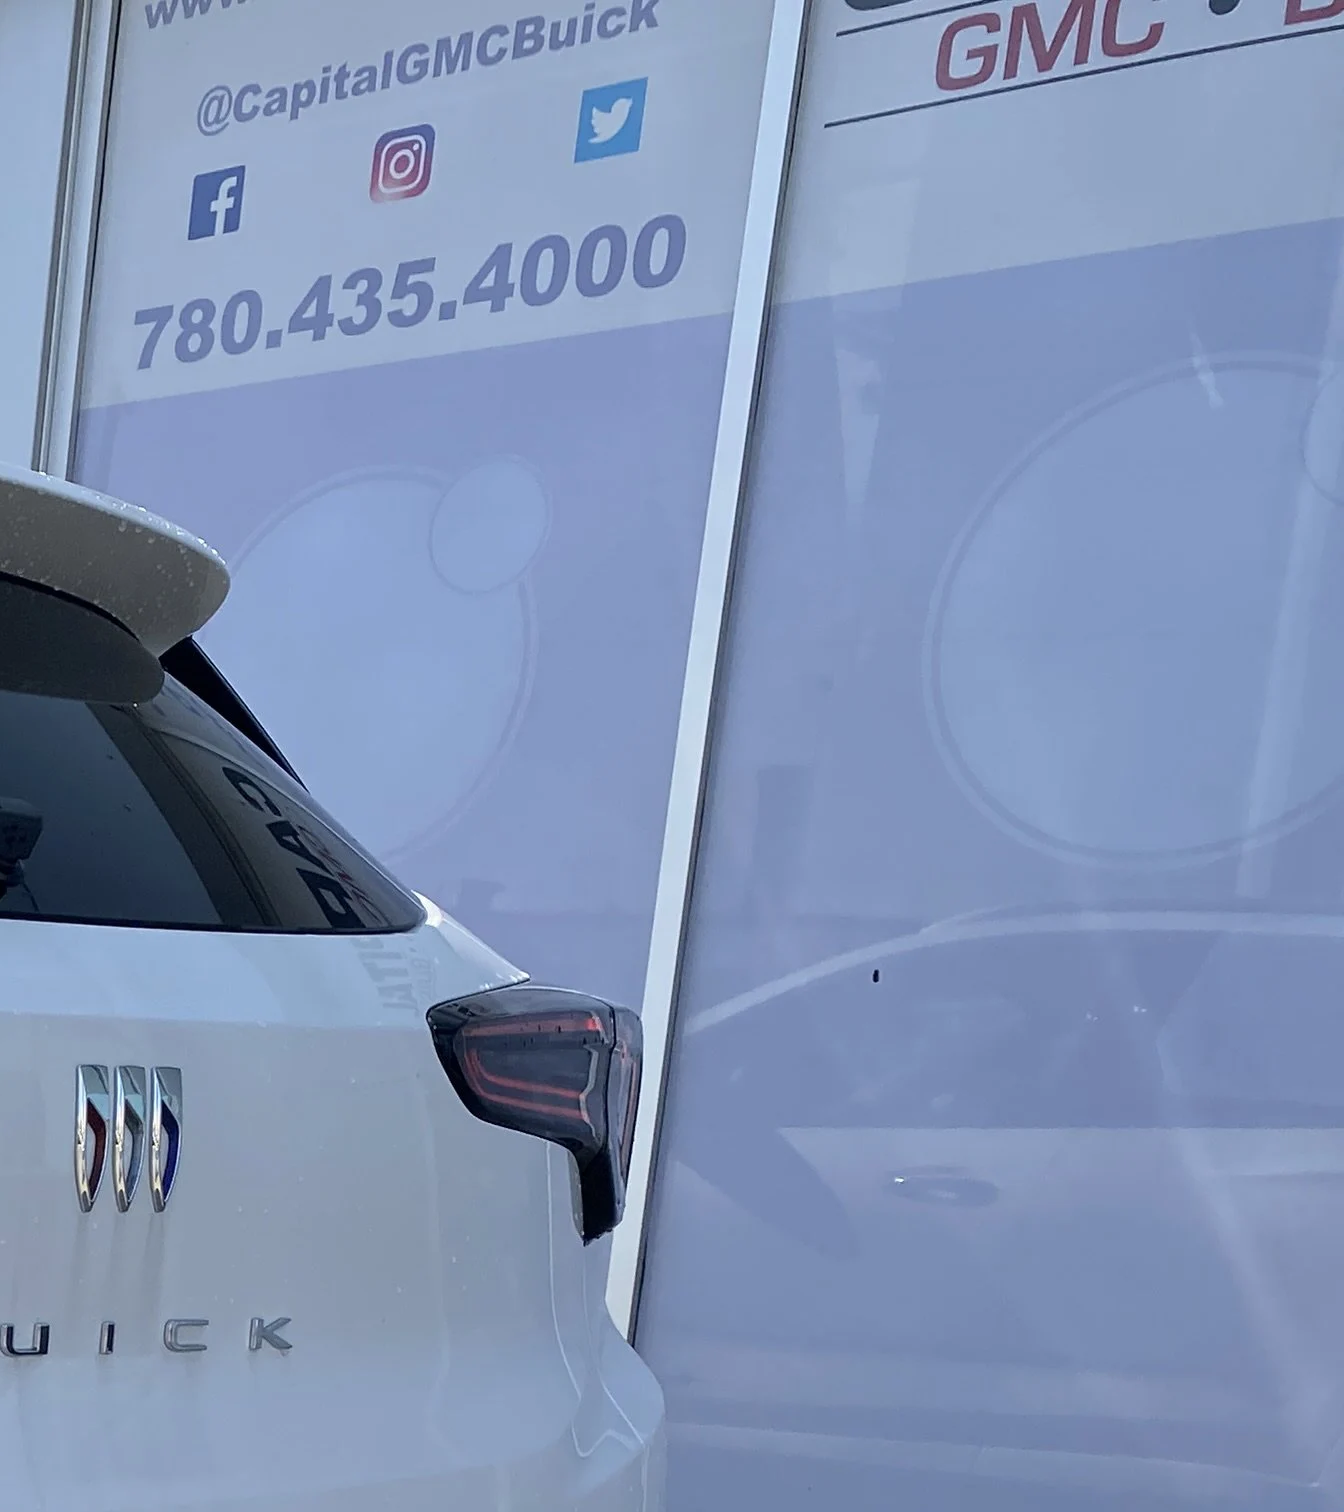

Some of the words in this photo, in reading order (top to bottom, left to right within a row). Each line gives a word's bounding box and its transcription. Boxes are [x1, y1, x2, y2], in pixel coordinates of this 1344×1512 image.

[197, 0, 660, 136] @CapitalGMCBuick
[935, 0, 1165, 91] GMC
[132, 214, 687, 370] 780.435.4000
